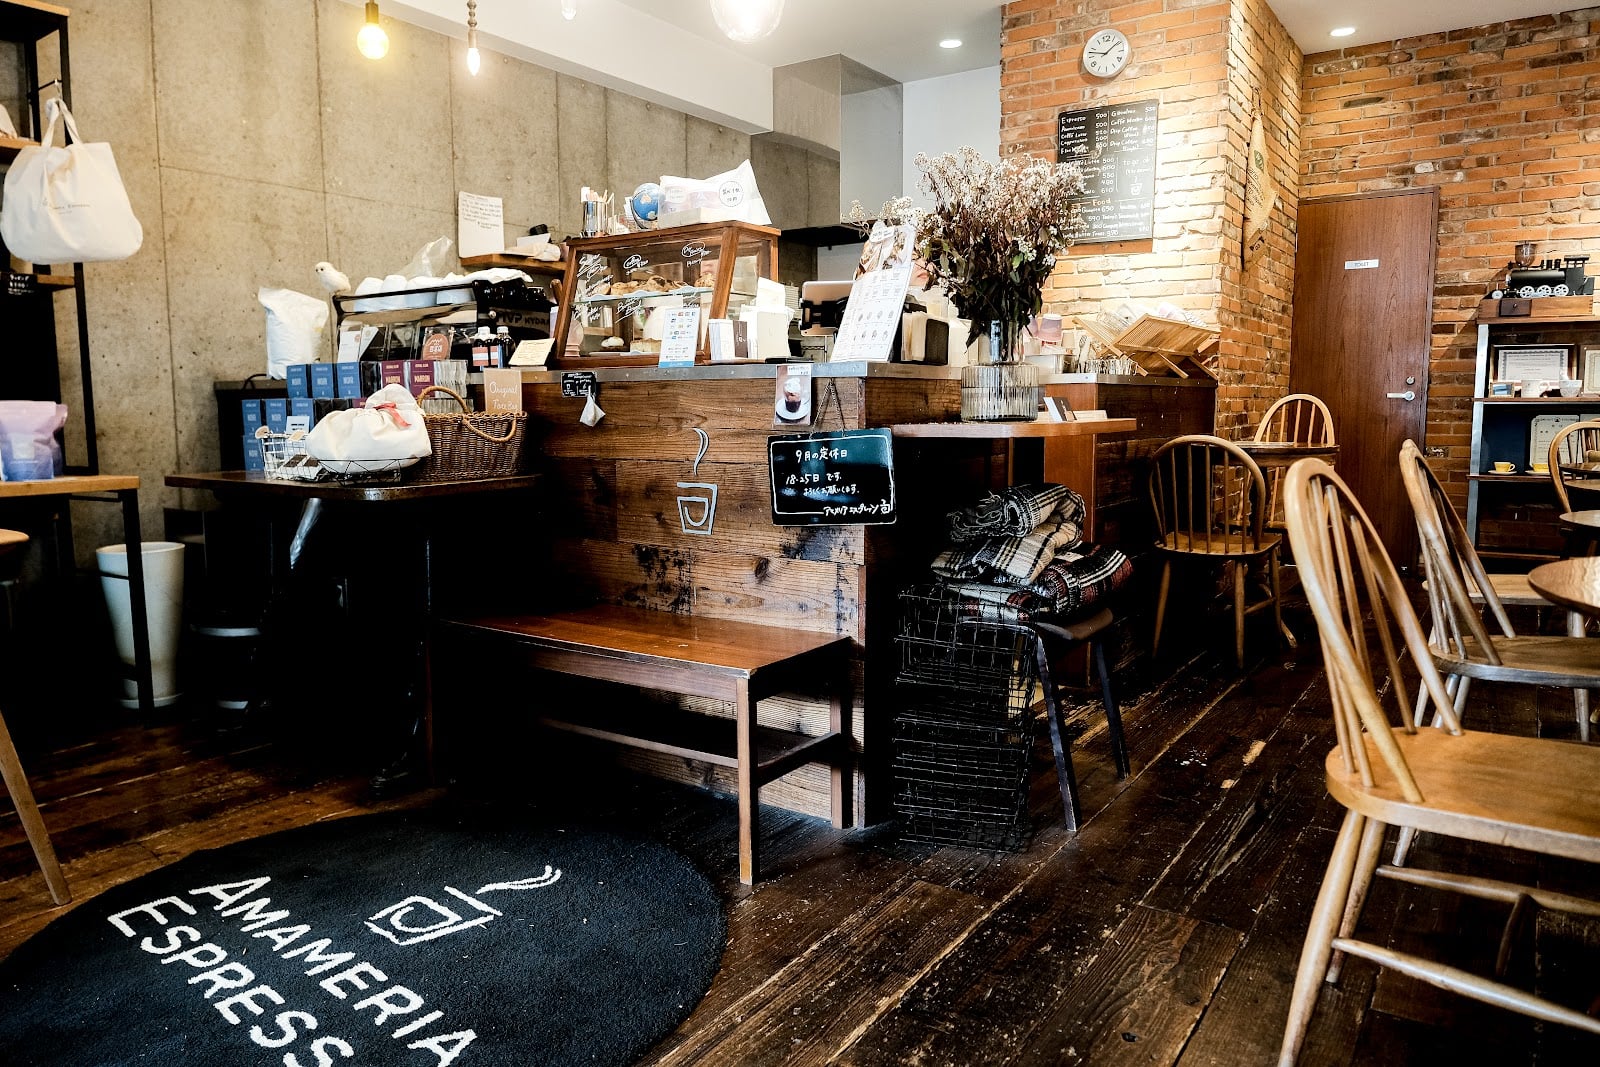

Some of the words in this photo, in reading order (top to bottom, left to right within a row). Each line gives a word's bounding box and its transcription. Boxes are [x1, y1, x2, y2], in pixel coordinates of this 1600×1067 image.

[1093, 198, 1111, 206] Food
[490, 382, 517, 397] Original
[796, 446, 848, 463] 9月の定休日
[189, 876, 476, 1067] AMAMERIA
[107, 896, 354, 1067] ESPRESS
